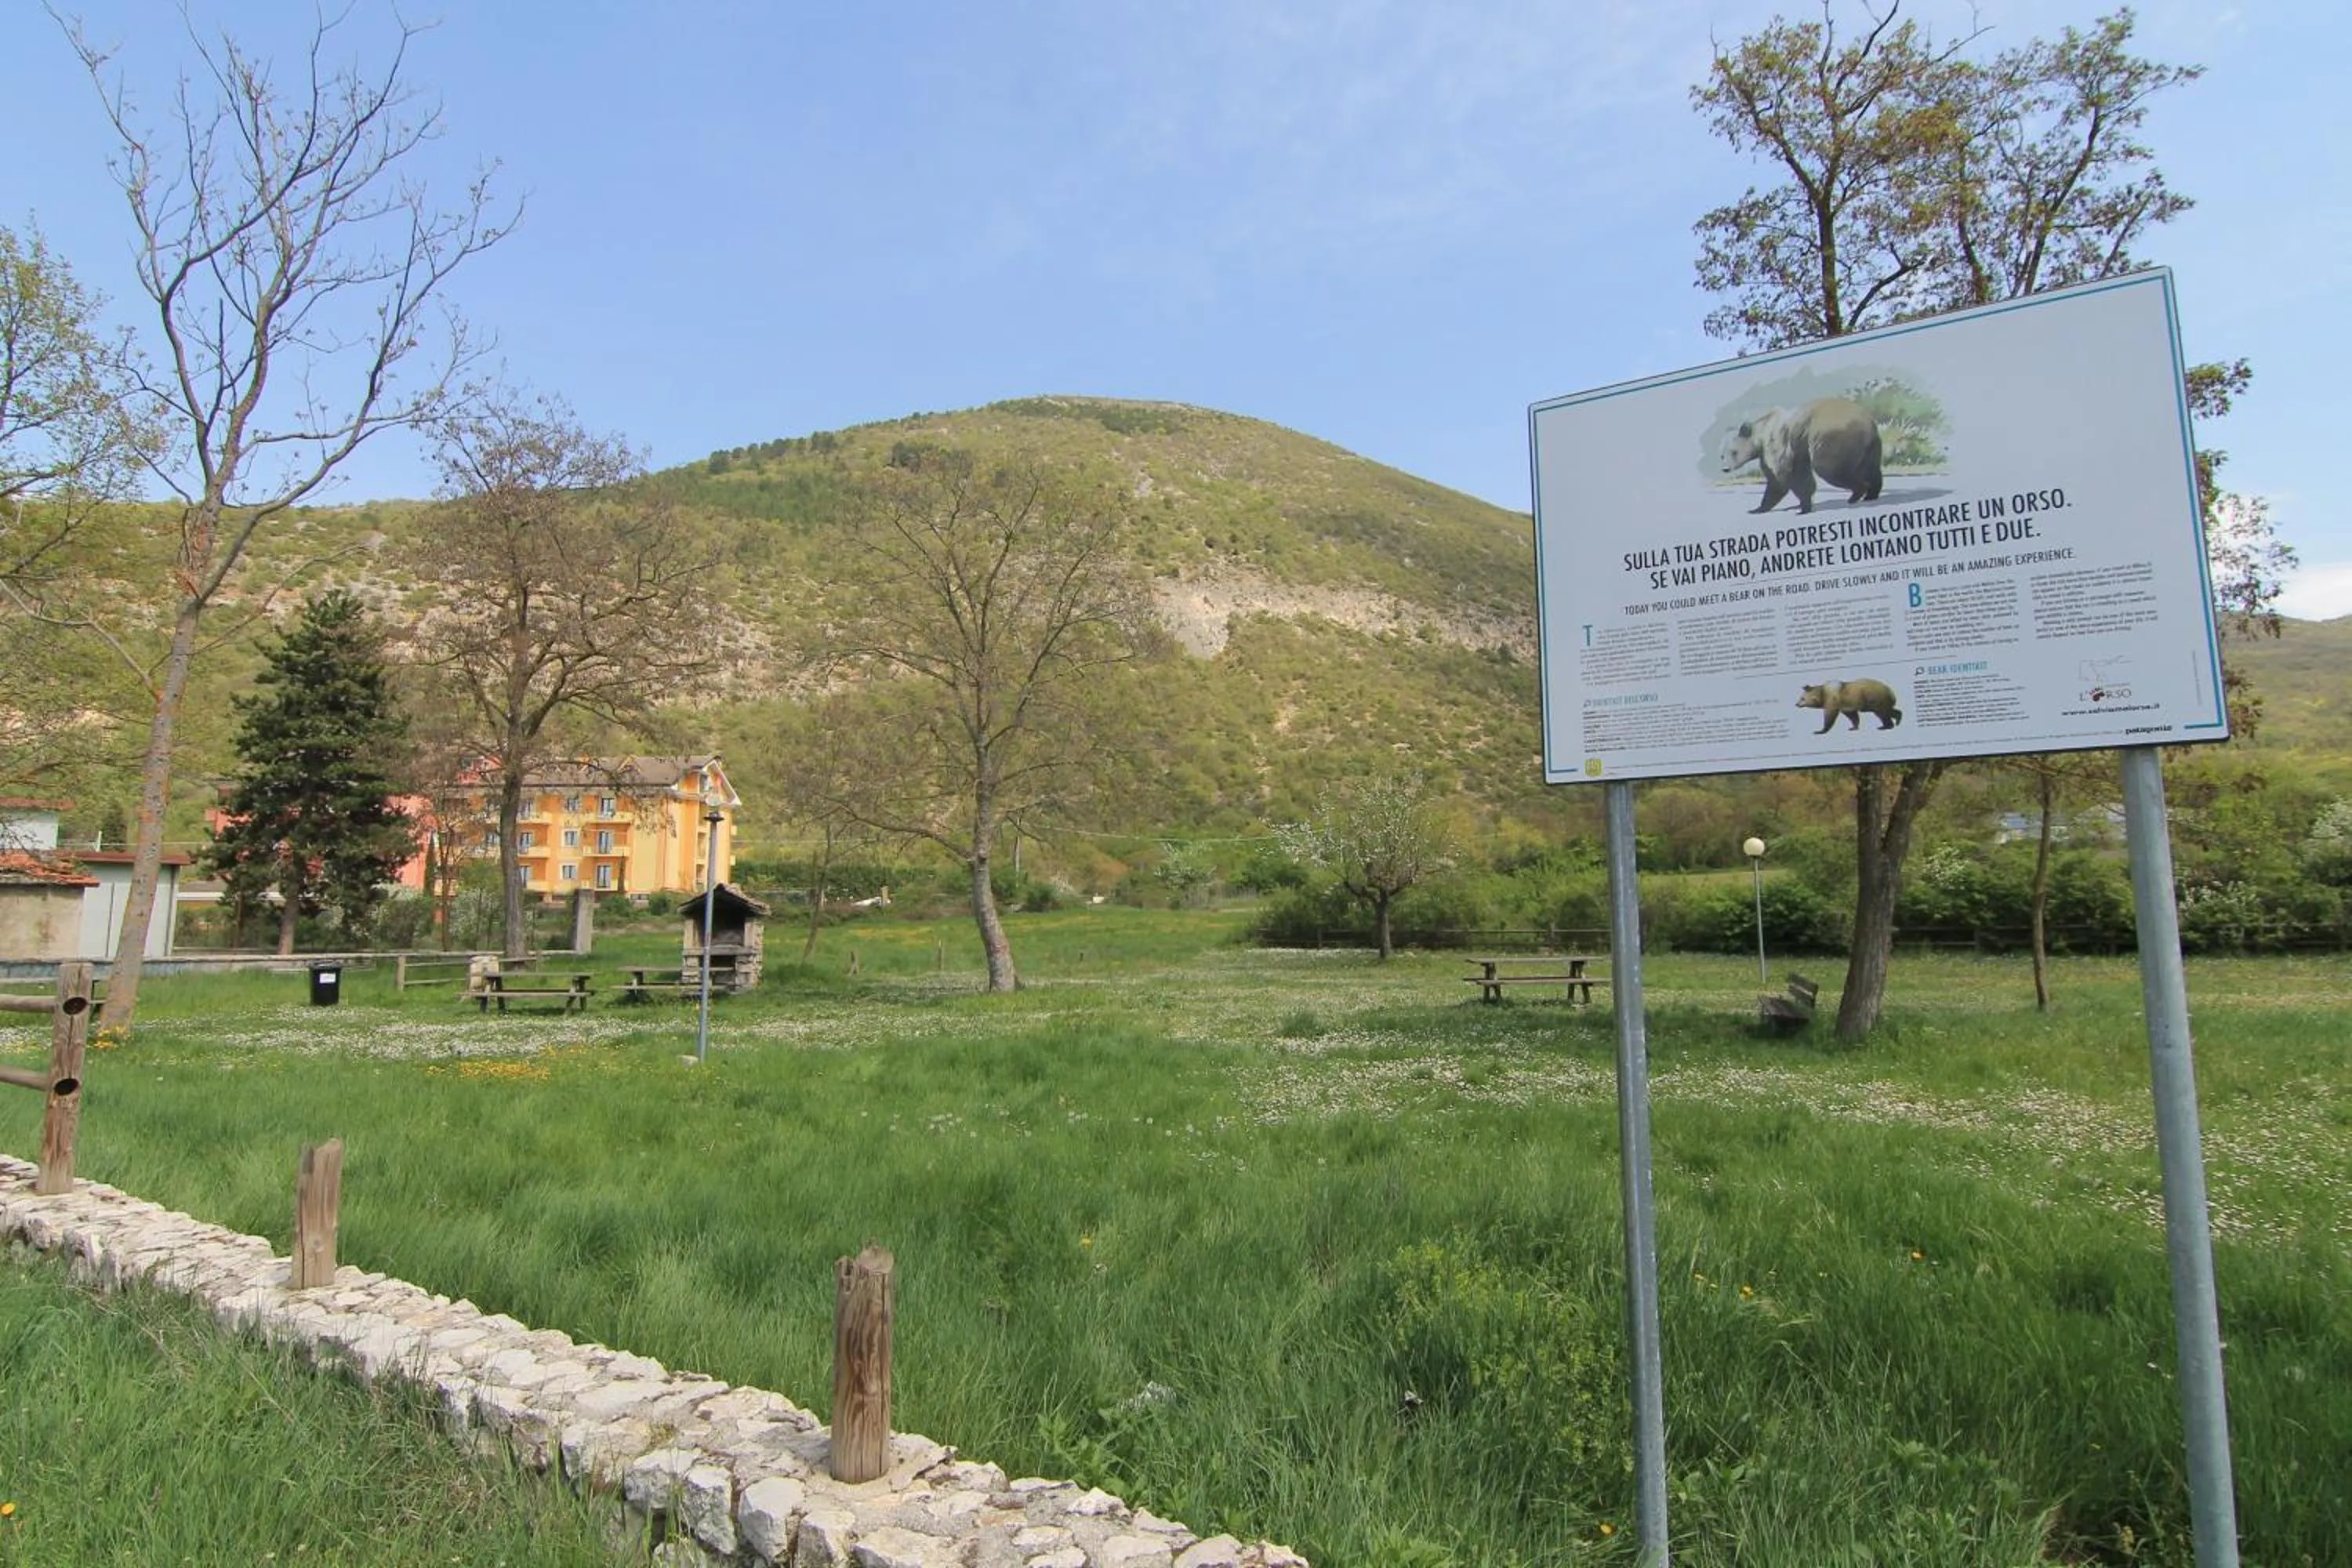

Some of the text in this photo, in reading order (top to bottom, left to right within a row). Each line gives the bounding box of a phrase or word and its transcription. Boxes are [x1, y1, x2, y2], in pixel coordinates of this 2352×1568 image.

[1624, 488, 2072, 572] SULLA TUA STRADA POTRESTI INCONTRARE UN ORSO.
[1650, 517, 2042, 590] SE VAI PIANO, ANDRETE LONTANO TUTTI E DUE.
[1624, 604, 1649, 615] TODAY
[1652, 601, 1668, 612] YOU
[1669, 597, 1696, 609] COULD
[1698, 593, 1720, 605] MEET
[1721, 593, 1727, 602] A
[1729, 590, 1751, 602] BEAR
[1752, 588, 1765, 599] ON
[1768, 586, 1783, 597] THE
[1815, 579, 1841, 591] DRIVE
[1843, 574, 1877, 588] SLOWLY
[1880, 570, 1899, 582] AND
[1901, 568, 1910, 579] IT
[1912, 566, 1934, 578] WILL
[1937, 564, 1949, 575] BE
[1951, 561, 1965, 573] AN
[1967, 555, 2013, 570] AMAZING
[2015, 547, 2076, 565] EXPERIENCE.
